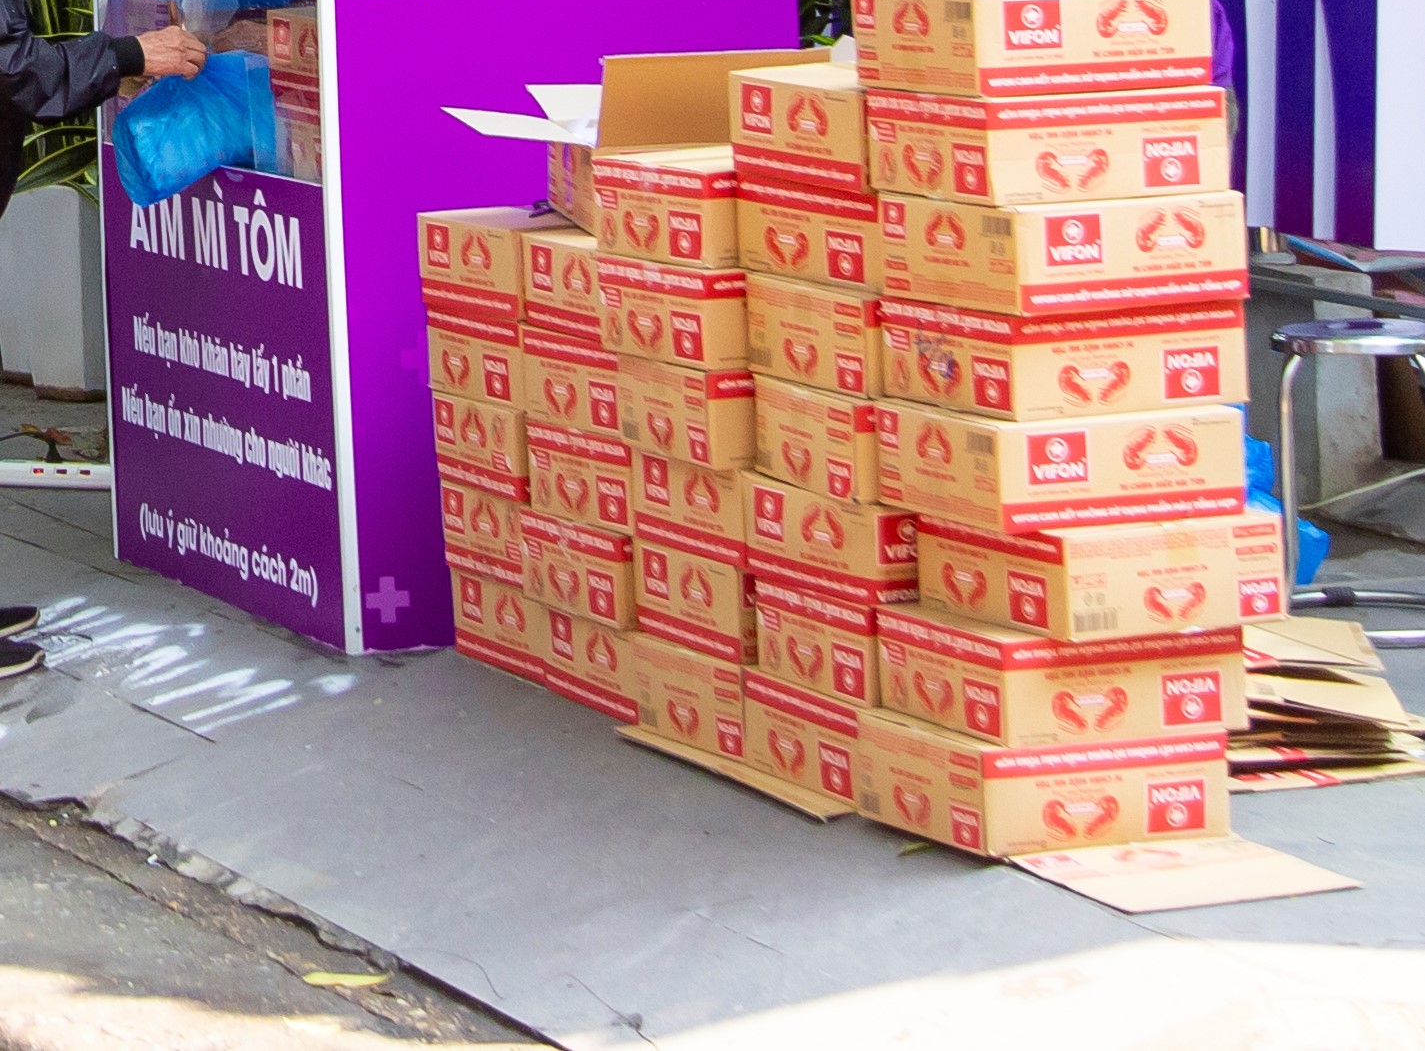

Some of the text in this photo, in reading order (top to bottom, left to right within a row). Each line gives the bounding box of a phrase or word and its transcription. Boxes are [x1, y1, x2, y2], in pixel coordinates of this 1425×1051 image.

[1008, 28, 1060, 46] VIFON
[1145, 141, 1194, 158] VIFON
[130, 178, 303, 289] ATM MÌ TÔM
[1049, 243, 1099, 262] VIFON
[133, 312, 311, 402] Nếu bạn khó khăn hãy lấy 1 phần
[1166, 352, 1215, 370] VIFON
[122, 383, 331, 491] Nếu bạn ổn xin nhường cho người khác
[1032, 462, 1085, 480] VIFON
[140, 503, 318, 608] (lưu ý giữ khoảng cách 2m)
[1166, 678, 1216, 695] VIFON
[1151, 786, 1201, 804] VIFON
